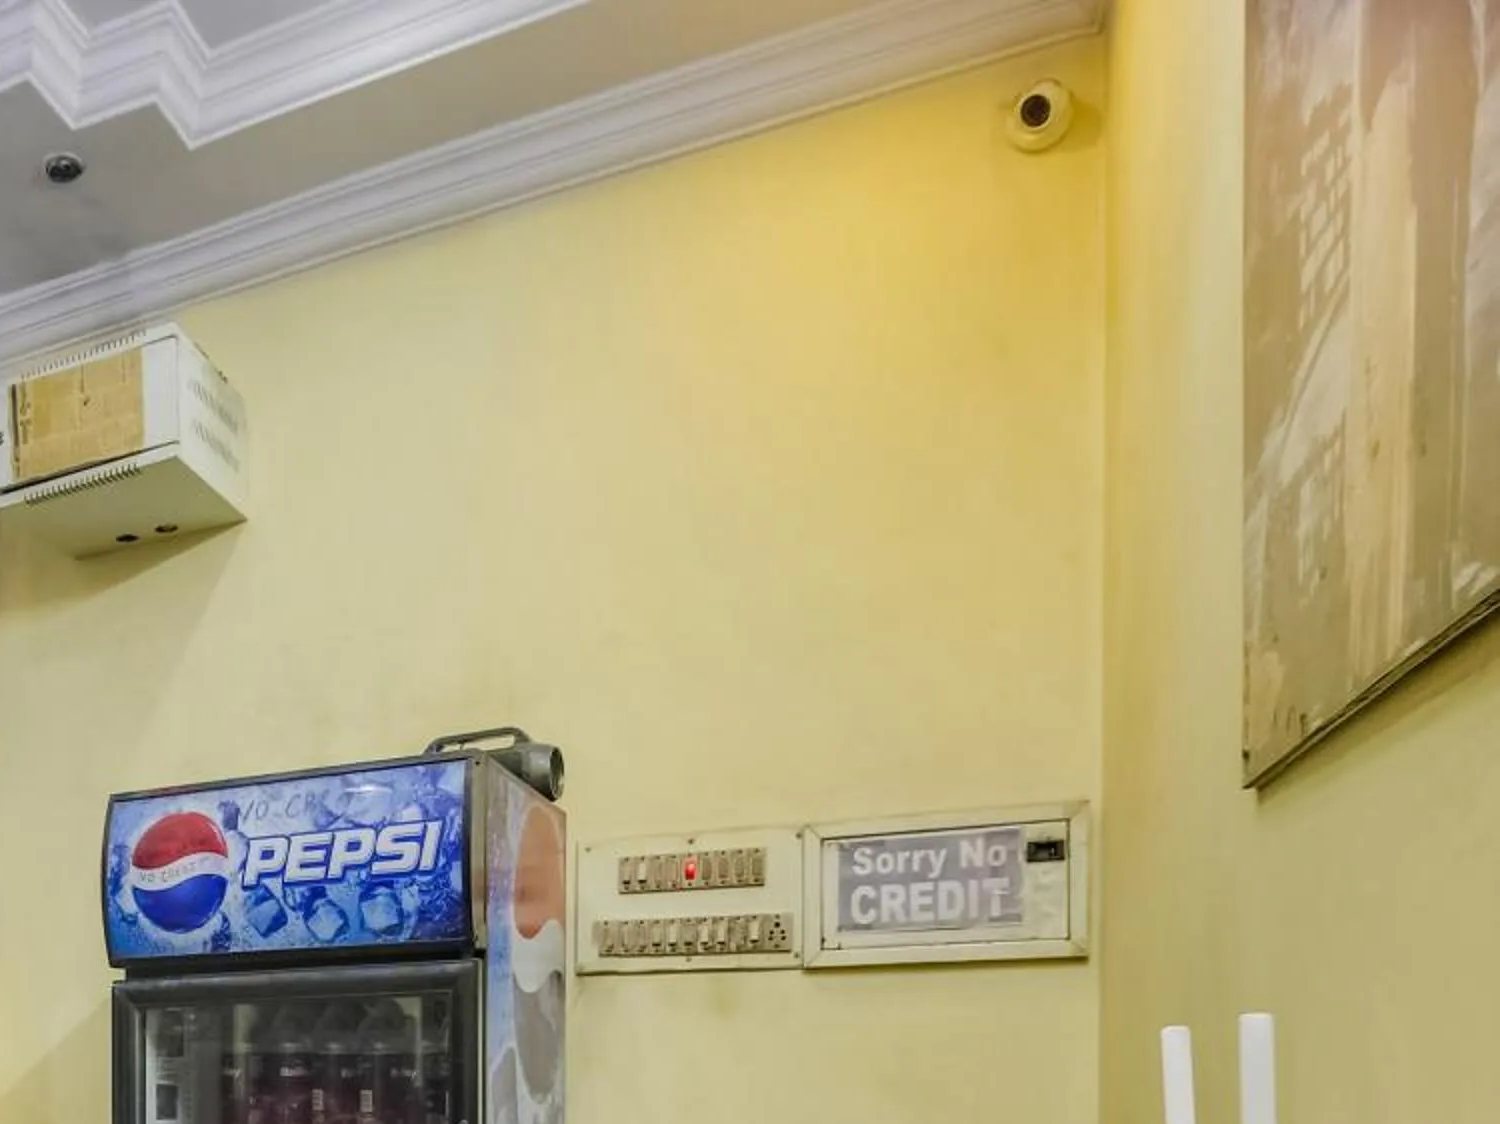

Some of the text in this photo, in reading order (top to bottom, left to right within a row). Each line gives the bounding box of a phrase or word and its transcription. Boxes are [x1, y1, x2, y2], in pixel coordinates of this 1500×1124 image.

[242, 820, 442, 889] PEPSI
[851, 835, 1008, 879] Sorry No
[850, 877, 1011, 925] CREDIT
